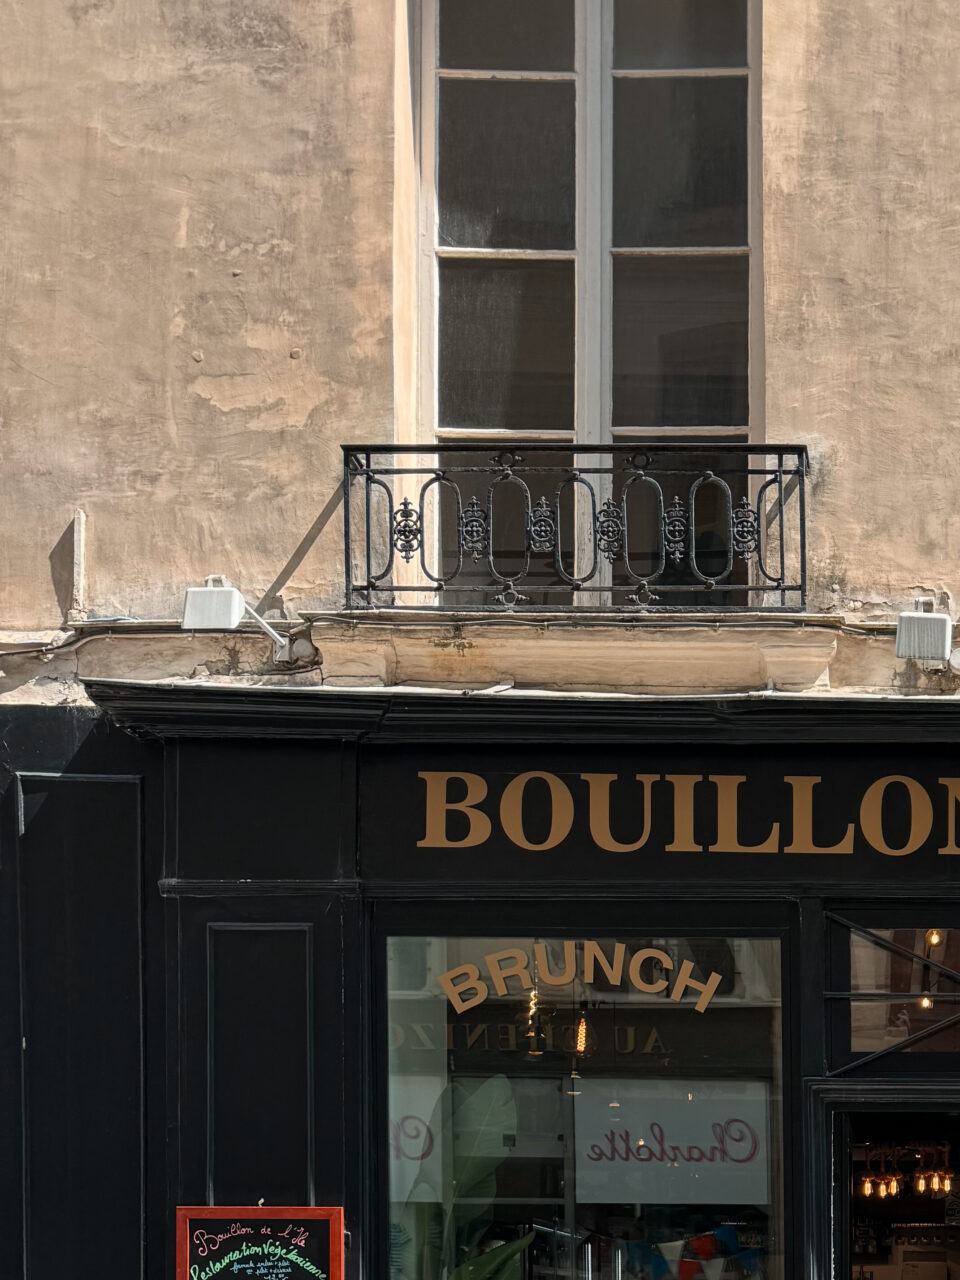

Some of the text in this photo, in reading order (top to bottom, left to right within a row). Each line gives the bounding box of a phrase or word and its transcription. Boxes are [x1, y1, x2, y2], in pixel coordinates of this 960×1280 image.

[438, 940, 723, 1014] BRUNCH
[193, 1223, 254, 1256] Bouillon
[261, 1226, 271, 1234] de
